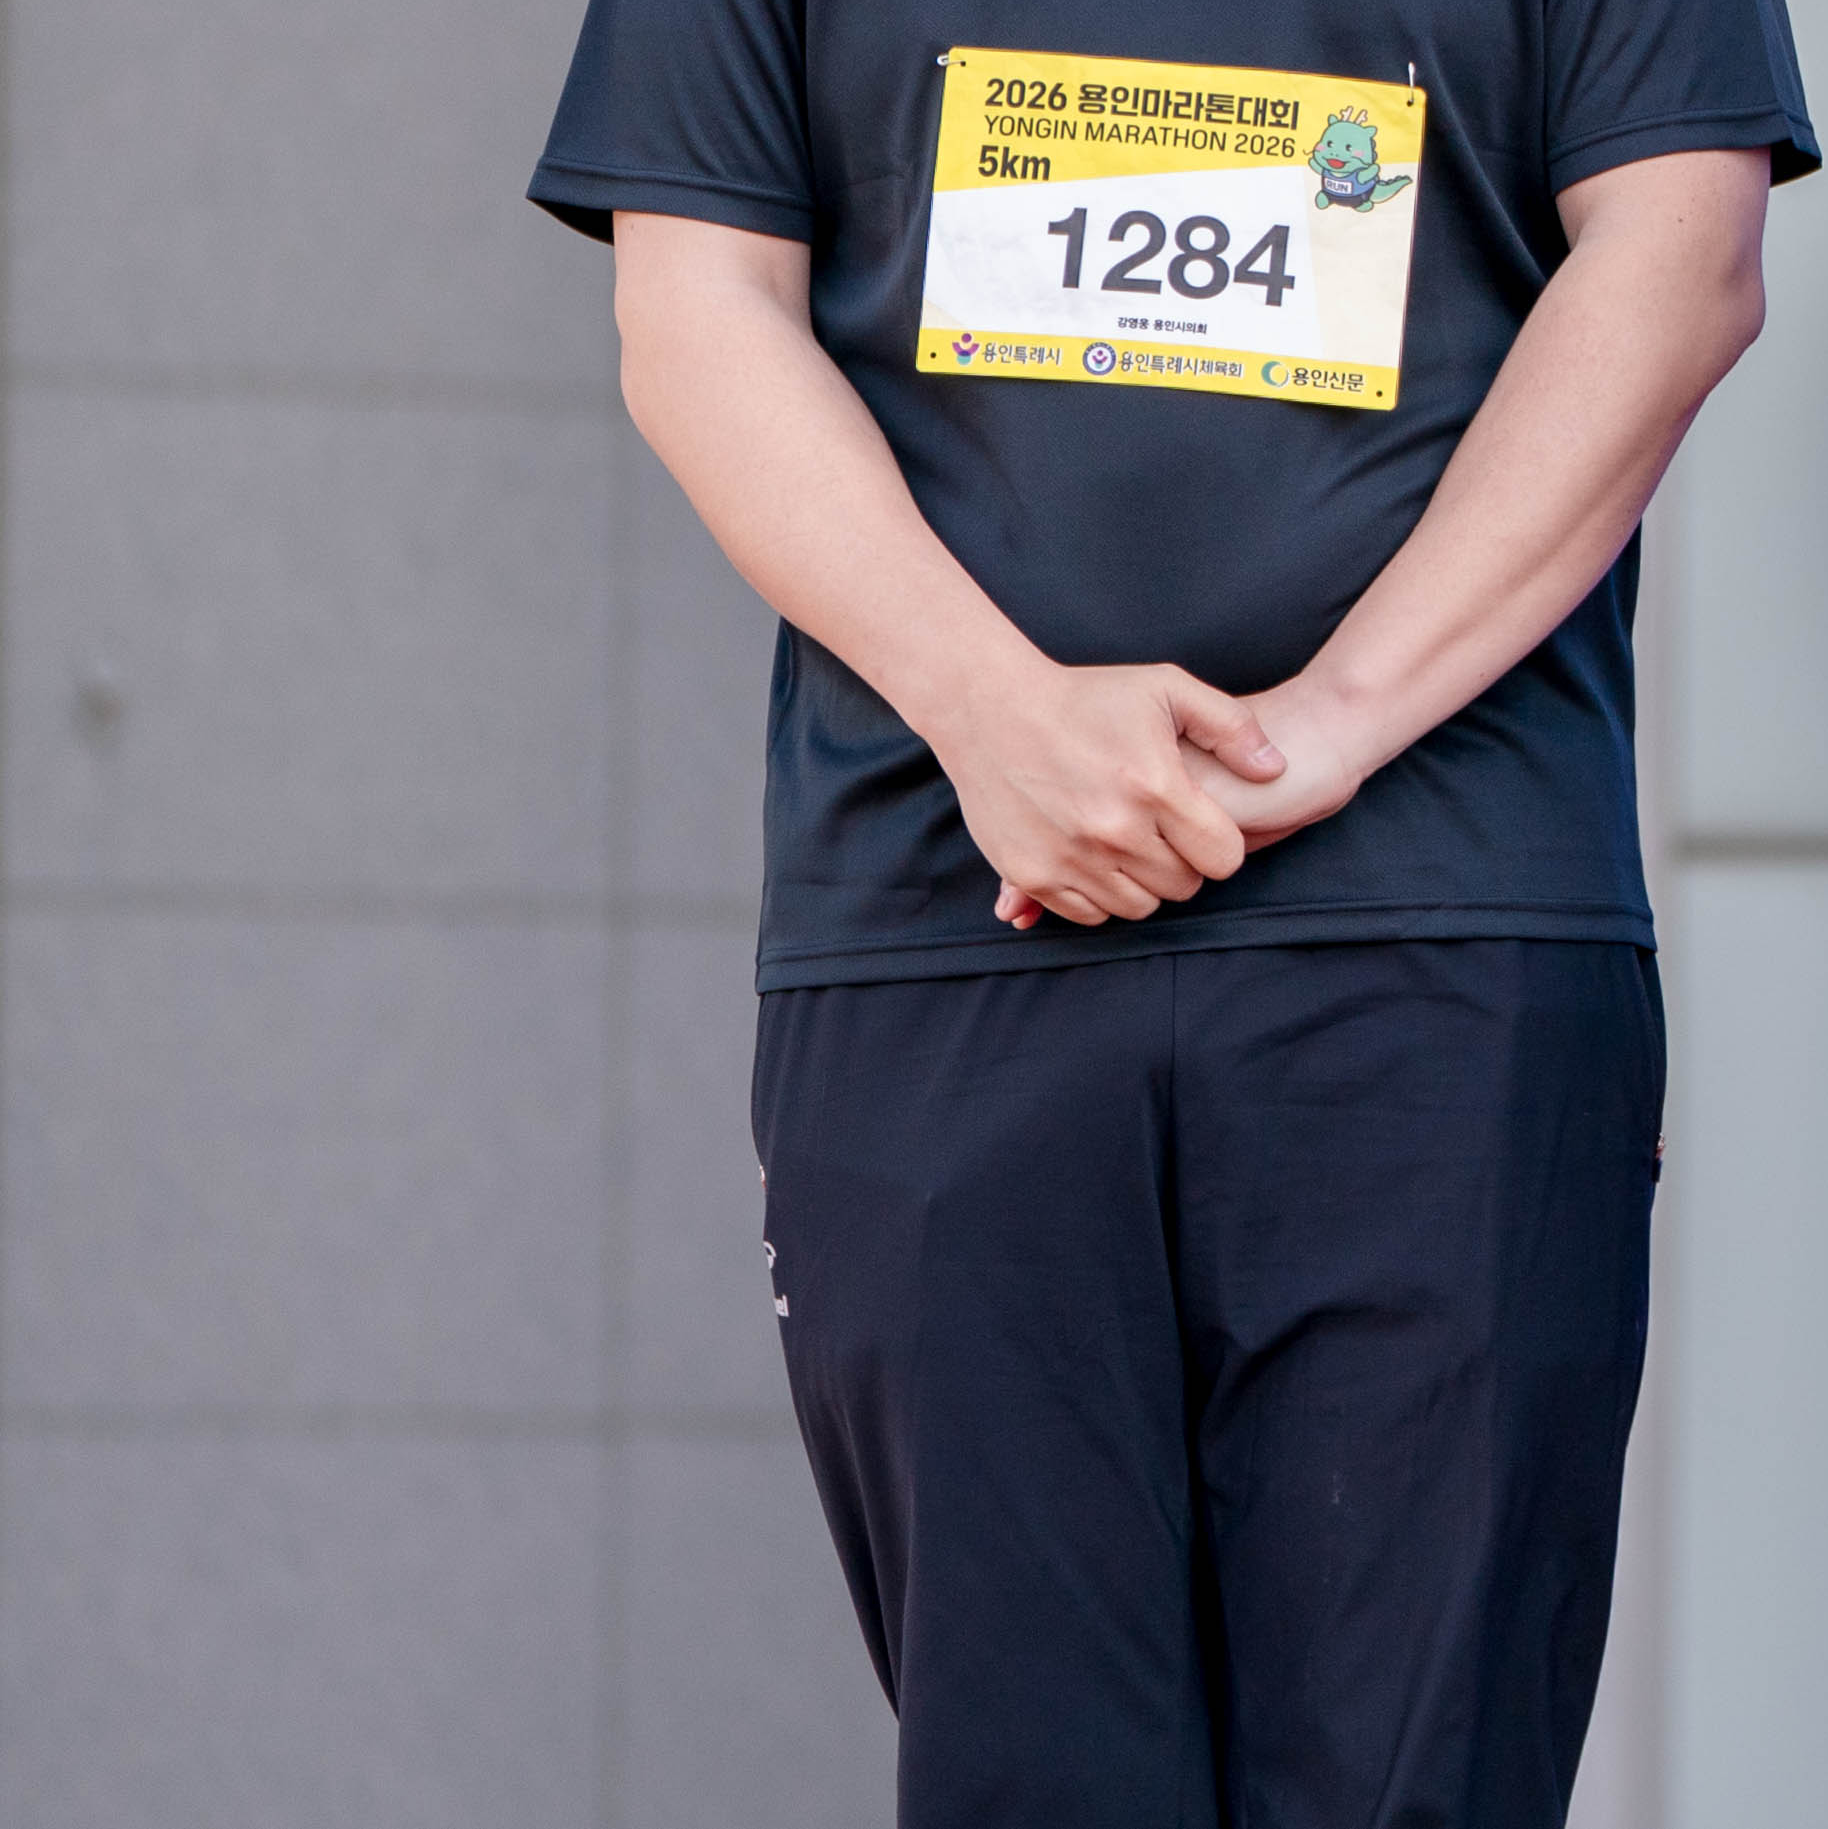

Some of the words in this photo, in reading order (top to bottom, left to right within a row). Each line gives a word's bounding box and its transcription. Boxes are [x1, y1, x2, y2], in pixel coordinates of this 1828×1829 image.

[984, 77, 1068, 112] 2026
[1077, 82, 1300, 131] 용인마라톤대회
[984, 113, 1078, 141] YONGIN
[1084, 121, 1227, 152] MARATHON
[1234, 132, 1296, 159] 2026
[977, 144, 1052, 181] 5km
[1047, 207, 1296, 307] 1284
[981, 341, 1062, 366] 용인특례시
[1117, 350, 1243, 378] 용인특례시체육회
[1291, 366, 1364, 392] 용인신문
